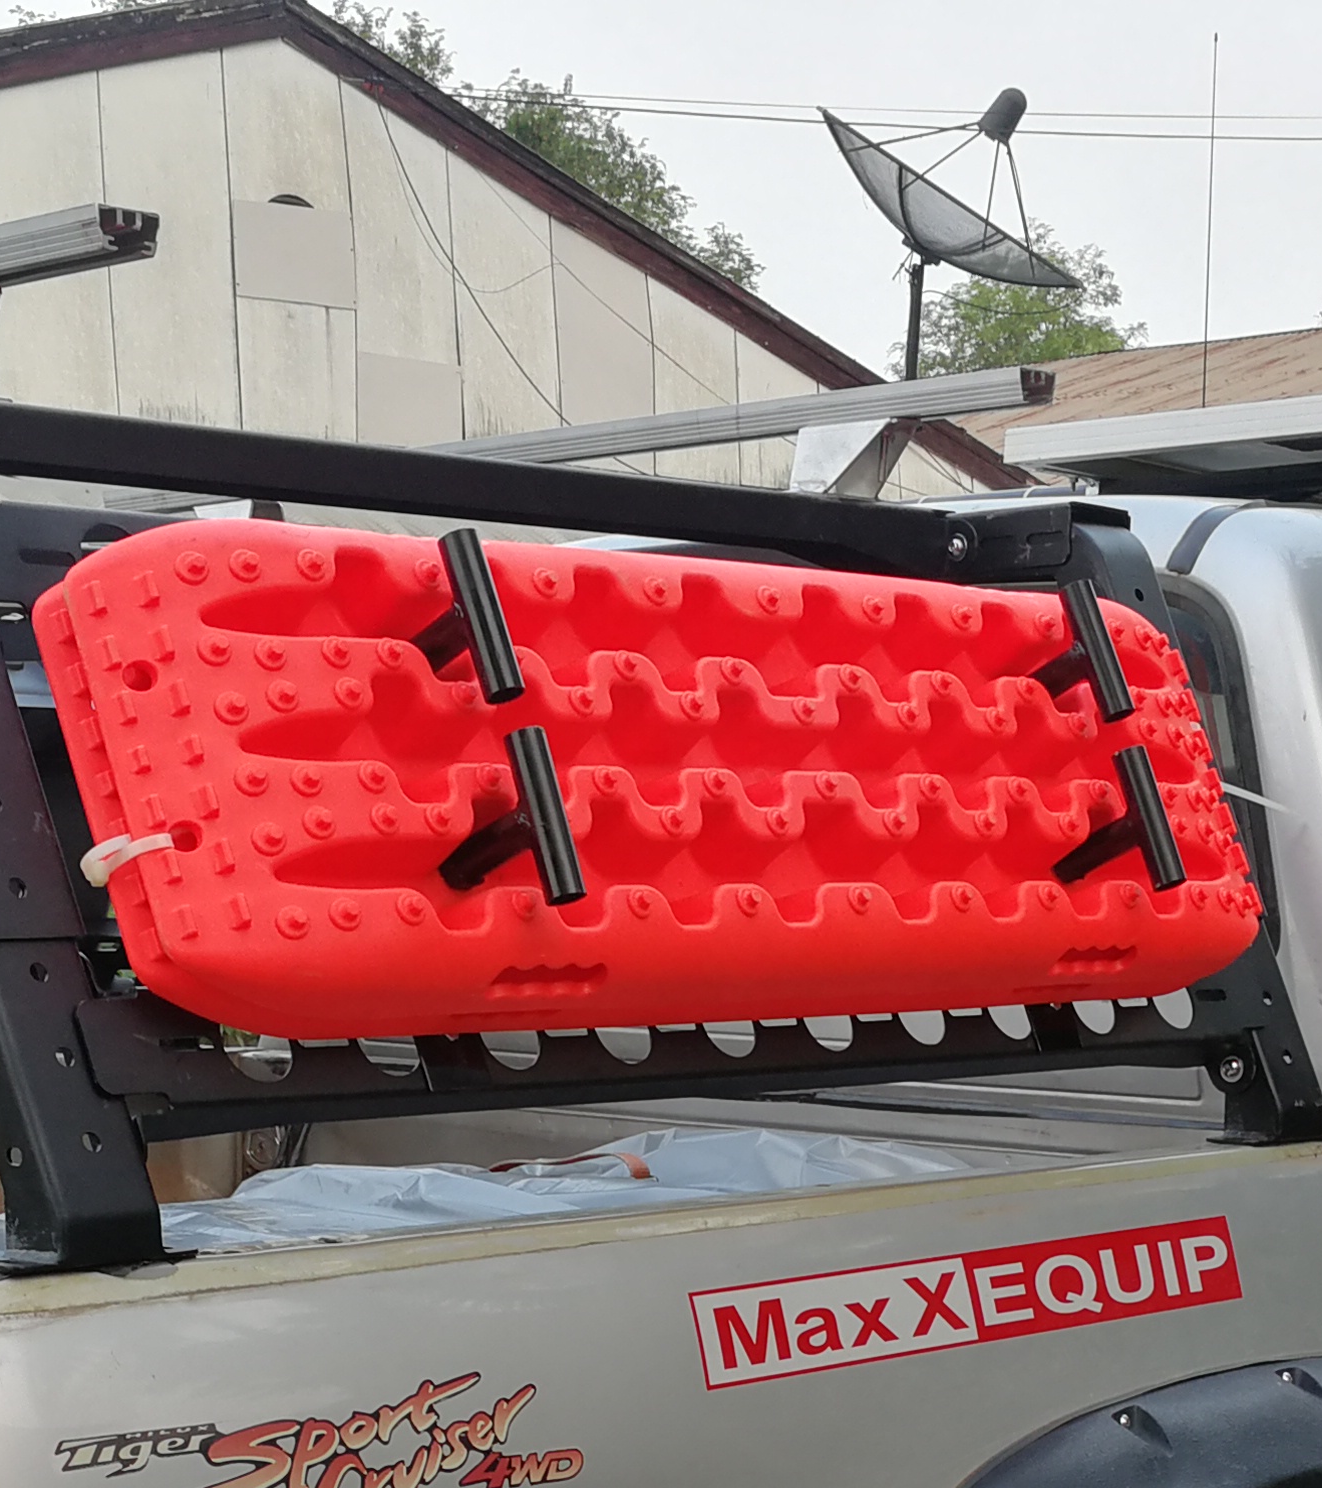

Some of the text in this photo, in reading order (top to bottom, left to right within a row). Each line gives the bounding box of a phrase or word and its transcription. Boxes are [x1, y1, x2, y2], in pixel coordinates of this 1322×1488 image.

[712, 1234, 1229, 1370] MaxX EQUIP
[55, 1432, 218, 1478] Tiger
